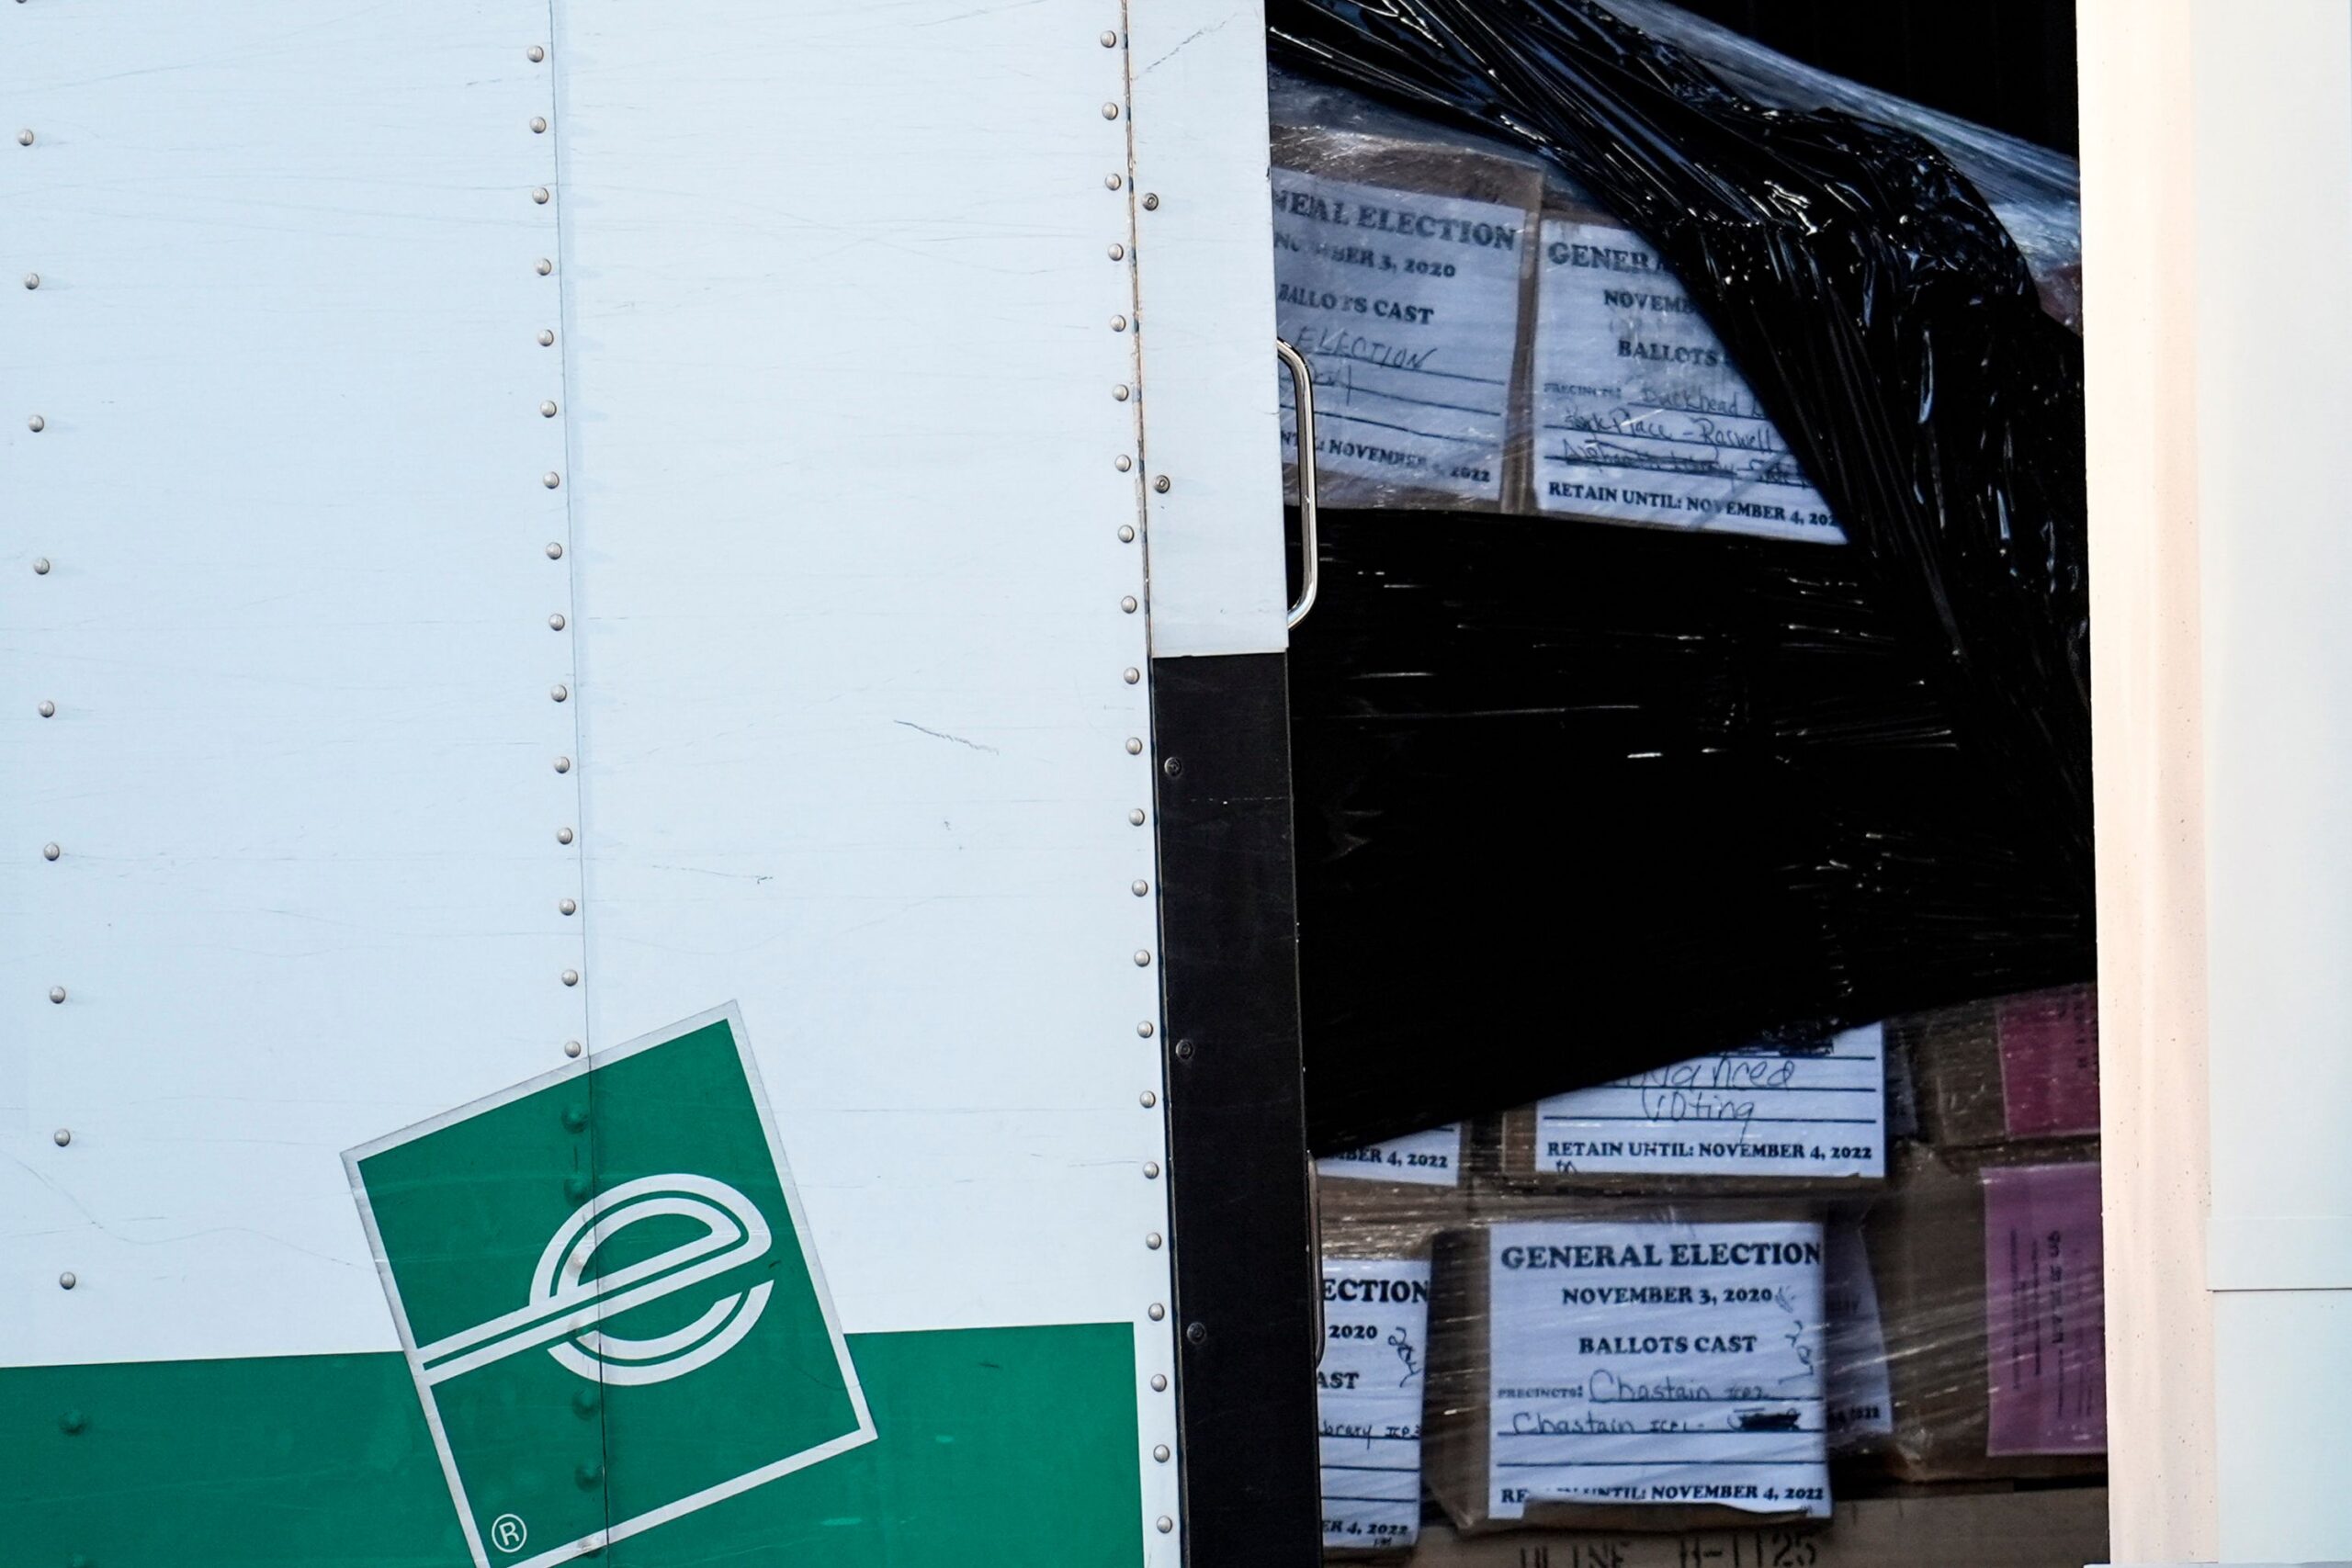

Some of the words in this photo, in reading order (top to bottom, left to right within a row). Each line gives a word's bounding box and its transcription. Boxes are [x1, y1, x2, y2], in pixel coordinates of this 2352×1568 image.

[1358, 204, 1517, 250] ELECTION
[1404, 258, 1456, 277] 2020
[1374, 299, 1434, 324] CAST
[1296, 326, 1438, 368] ELECTION
[1617, 339, 1719, 367] BALLOTS
[1548, 481, 1618, 503] RETAIN
[1622, 489, 1682, 511] UNTIL:
[1386, 1151, 1403, 1168] 4,
[1407, 1154, 1449, 1168] 2022
[1547, 1142, 1624, 1157] RETAIN
[1627, 1142, 1694, 1157] UNTIL:
[1699, 1142, 1804, 1159] NOVEMBER
[1808, 1146, 1826, 1162] 4,
[1833, 1146, 1872, 1160] 2022
[1500, 1243, 1664, 1270] GENERAL
[1668, 1242, 1823, 1268] ELECTION
[1562, 1287, 1694, 1305] NOVEMBER
[1698, 1289, 1717, 1306] 3,
[1722, 1288, 1773, 1303] 2020
[1329, 1325, 1378, 1339] 2020
[1577, 1335, 1688, 1355] BALLOTS
[1694, 1335, 1758, 1354] CAST
[1589, 1368, 1713, 1402] Chastain
[1512, 1410, 1635, 1434] Chastain
[1650, 1484, 1759, 1500] NOVEMBER
[1762, 1487, 1781, 1503] 4,
[1783, 1487, 1825, 1501] 2022
[1366, 1523, 1409, 1536] 2022
